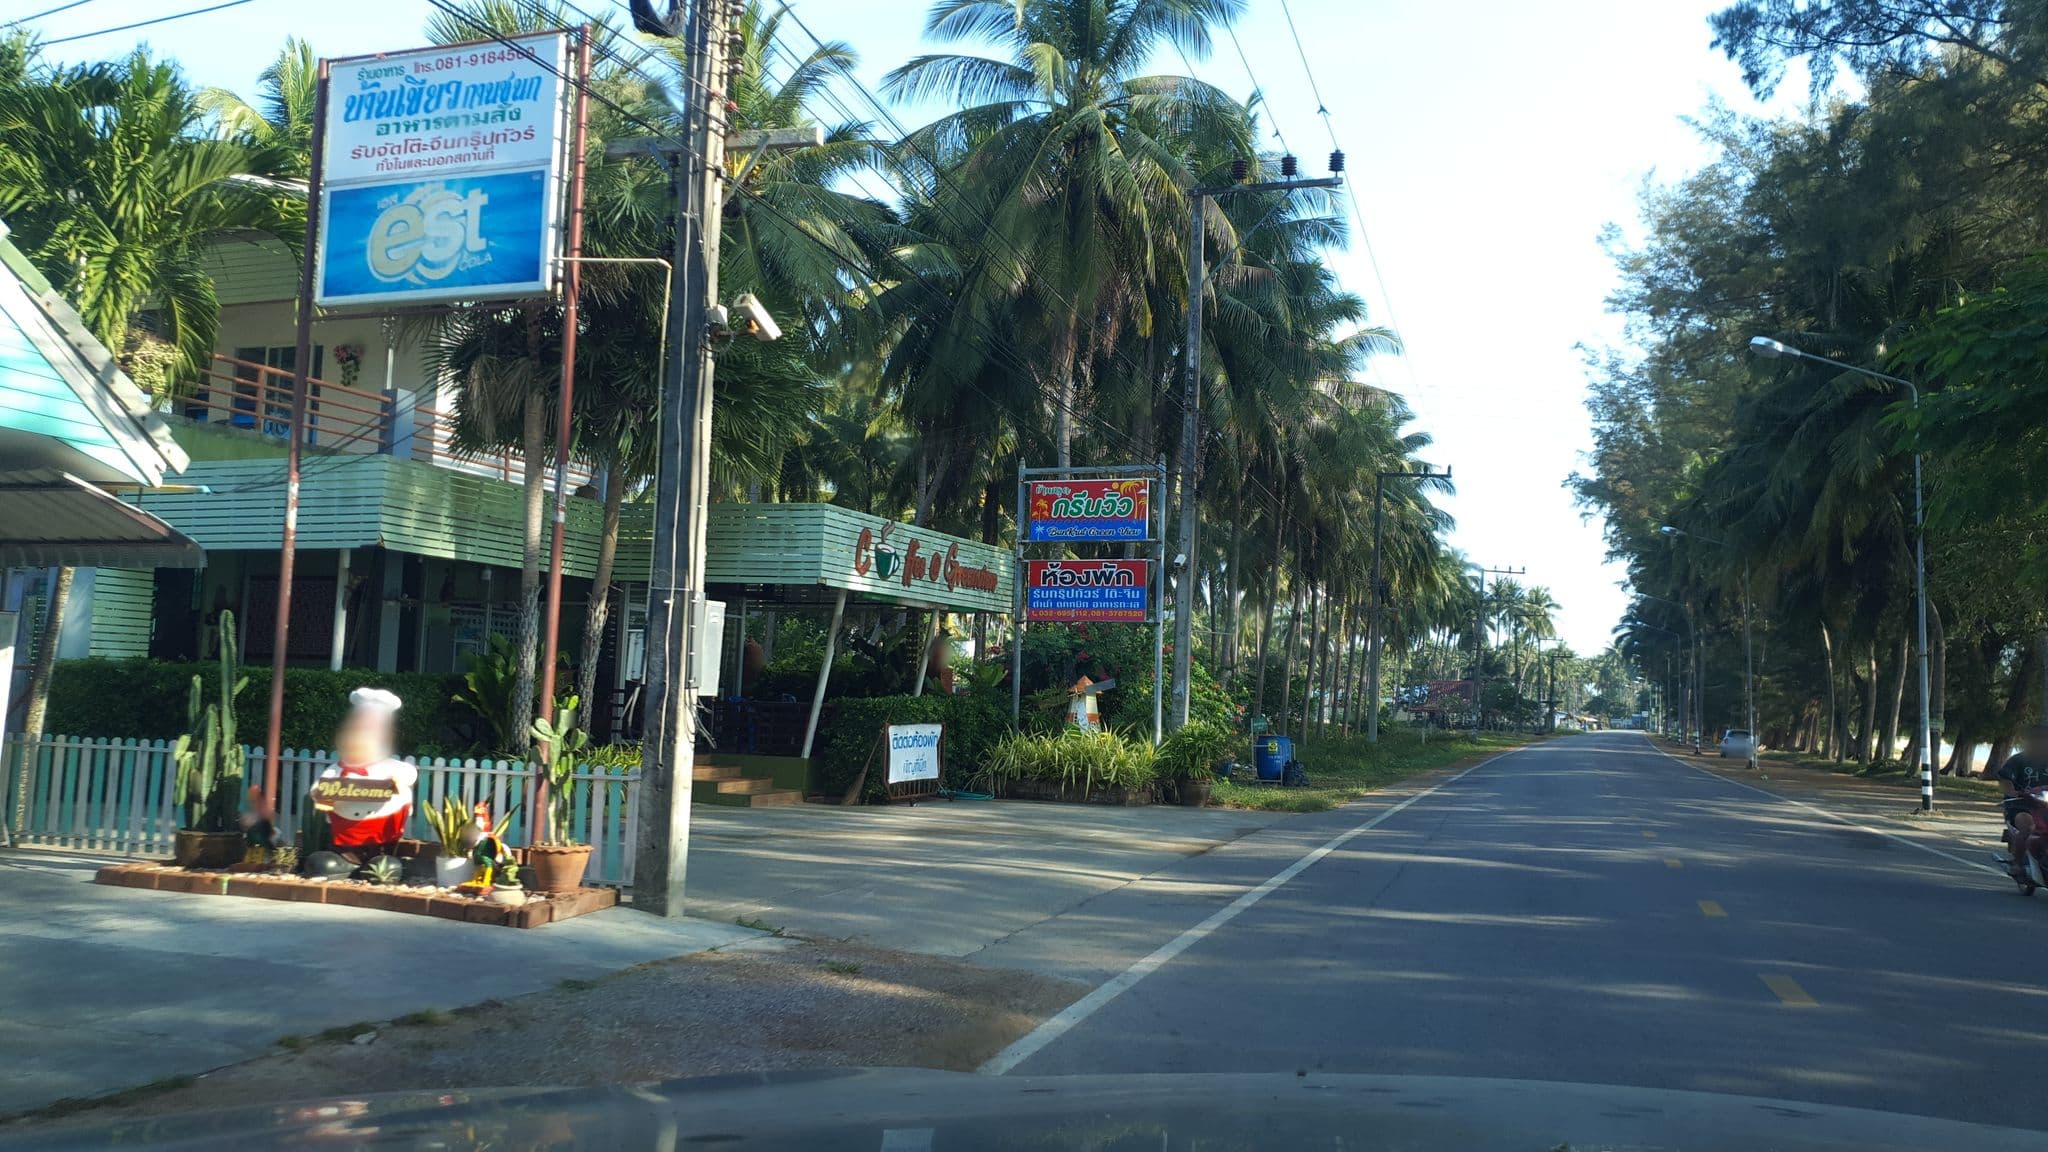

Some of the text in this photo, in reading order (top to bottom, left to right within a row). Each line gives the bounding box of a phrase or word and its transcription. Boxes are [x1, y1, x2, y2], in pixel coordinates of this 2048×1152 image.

[358, 65, 405, 81] ร้านอาหาร
[376, 104, 521, 137] อาหารตามสั่ง
[367, 188, 488, 284] est
[1052, 490, 1134, 518] กรีนวิว
[1041, 562, 1134, 586] ห้องพัก
[319, 781, 393, 797] Welcome
